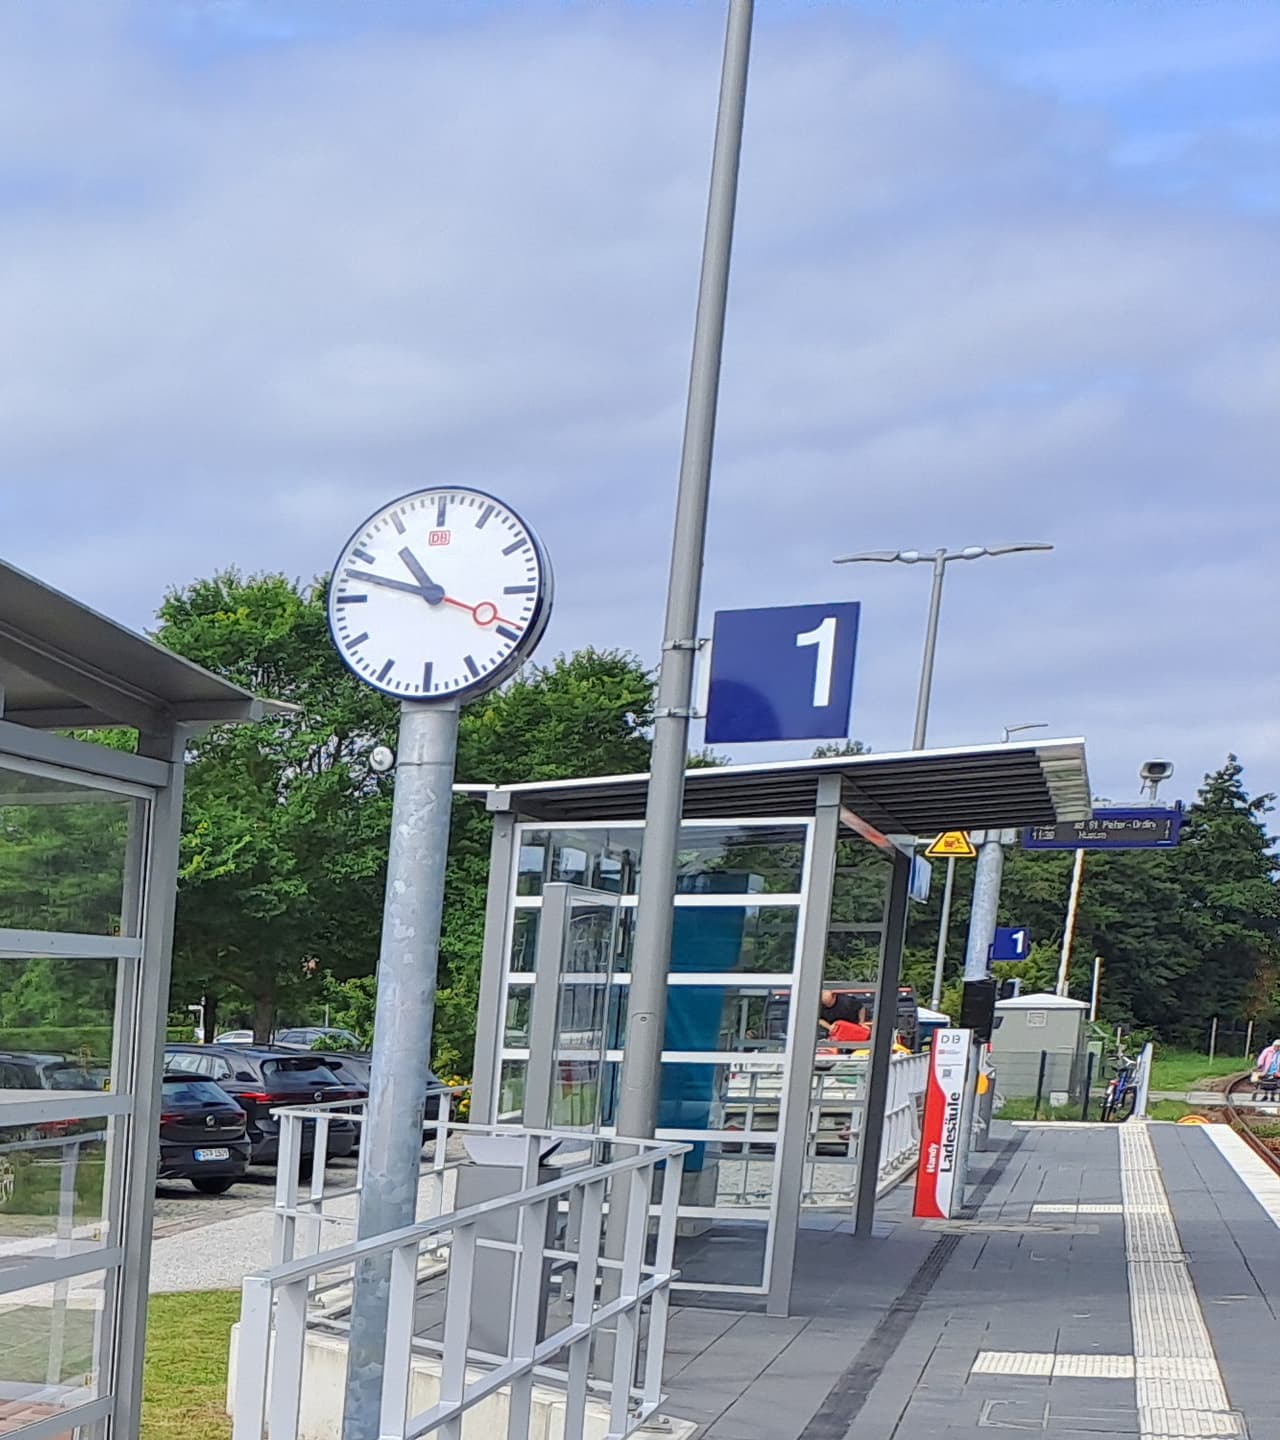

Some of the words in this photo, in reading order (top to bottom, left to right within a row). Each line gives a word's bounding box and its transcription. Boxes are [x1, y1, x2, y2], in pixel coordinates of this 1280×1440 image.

[431, 532, 448, 544] DB
[796, 617, 837, 707] 1
[1011, 930, 1025, 954] 1
[940, 1092, 961, 1173] Ladesäule
[926, 1142, 940, 1174] Handy
